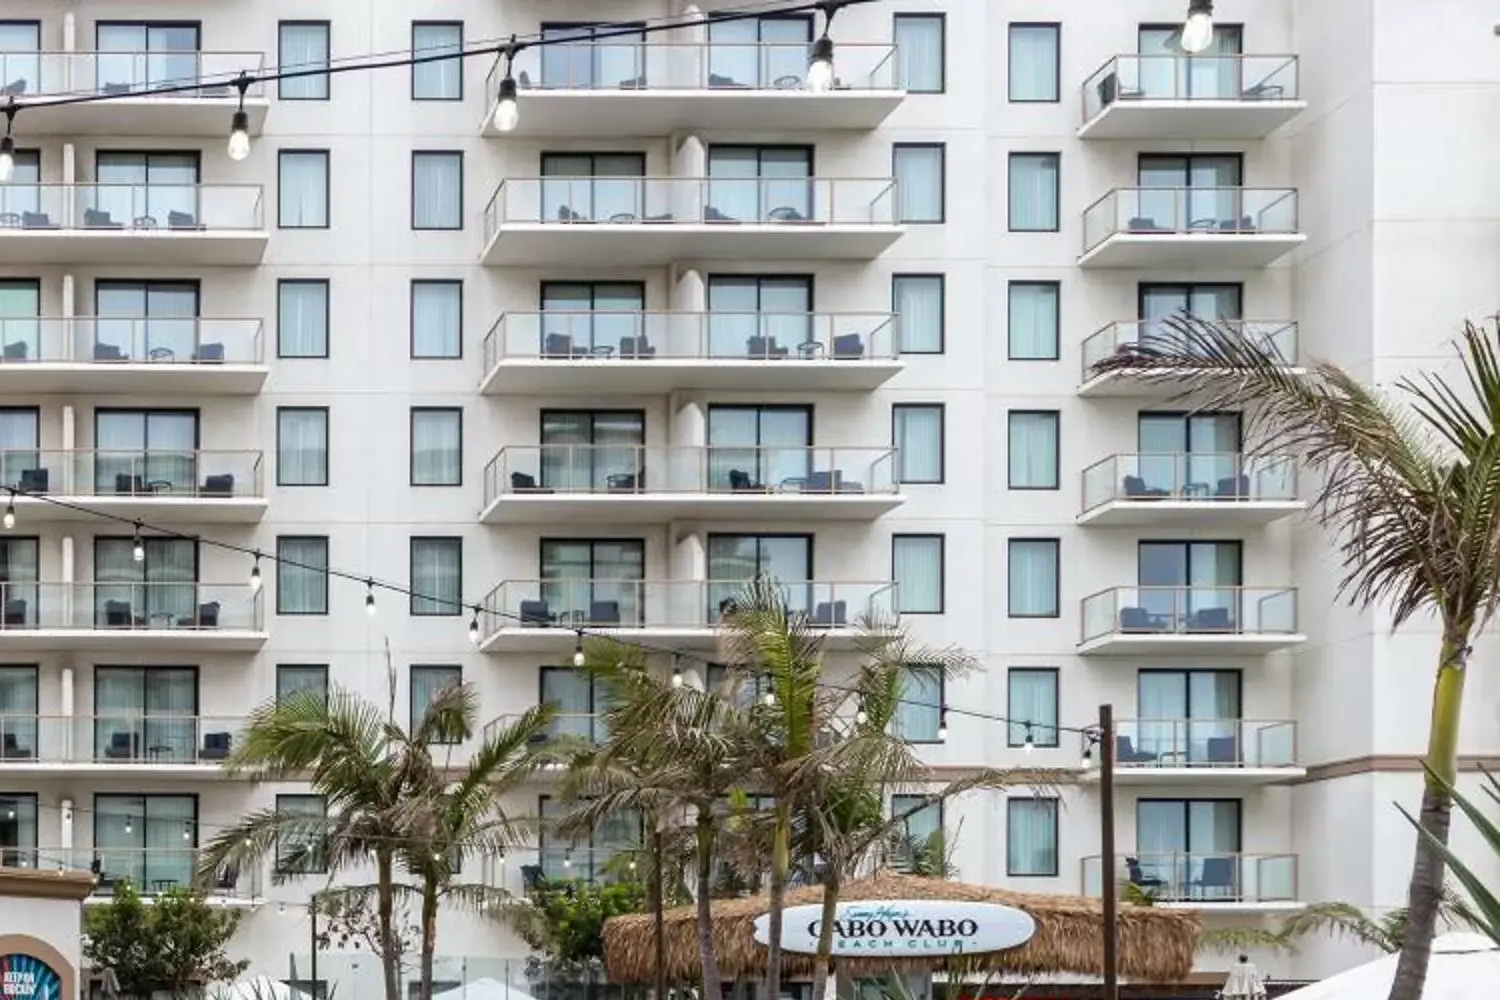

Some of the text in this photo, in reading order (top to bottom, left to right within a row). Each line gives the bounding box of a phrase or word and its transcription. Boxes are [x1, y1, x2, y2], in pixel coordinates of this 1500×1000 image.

[893, 918, 979, 938] WABO
[837, 939, 963, 949] EACH CLUB
